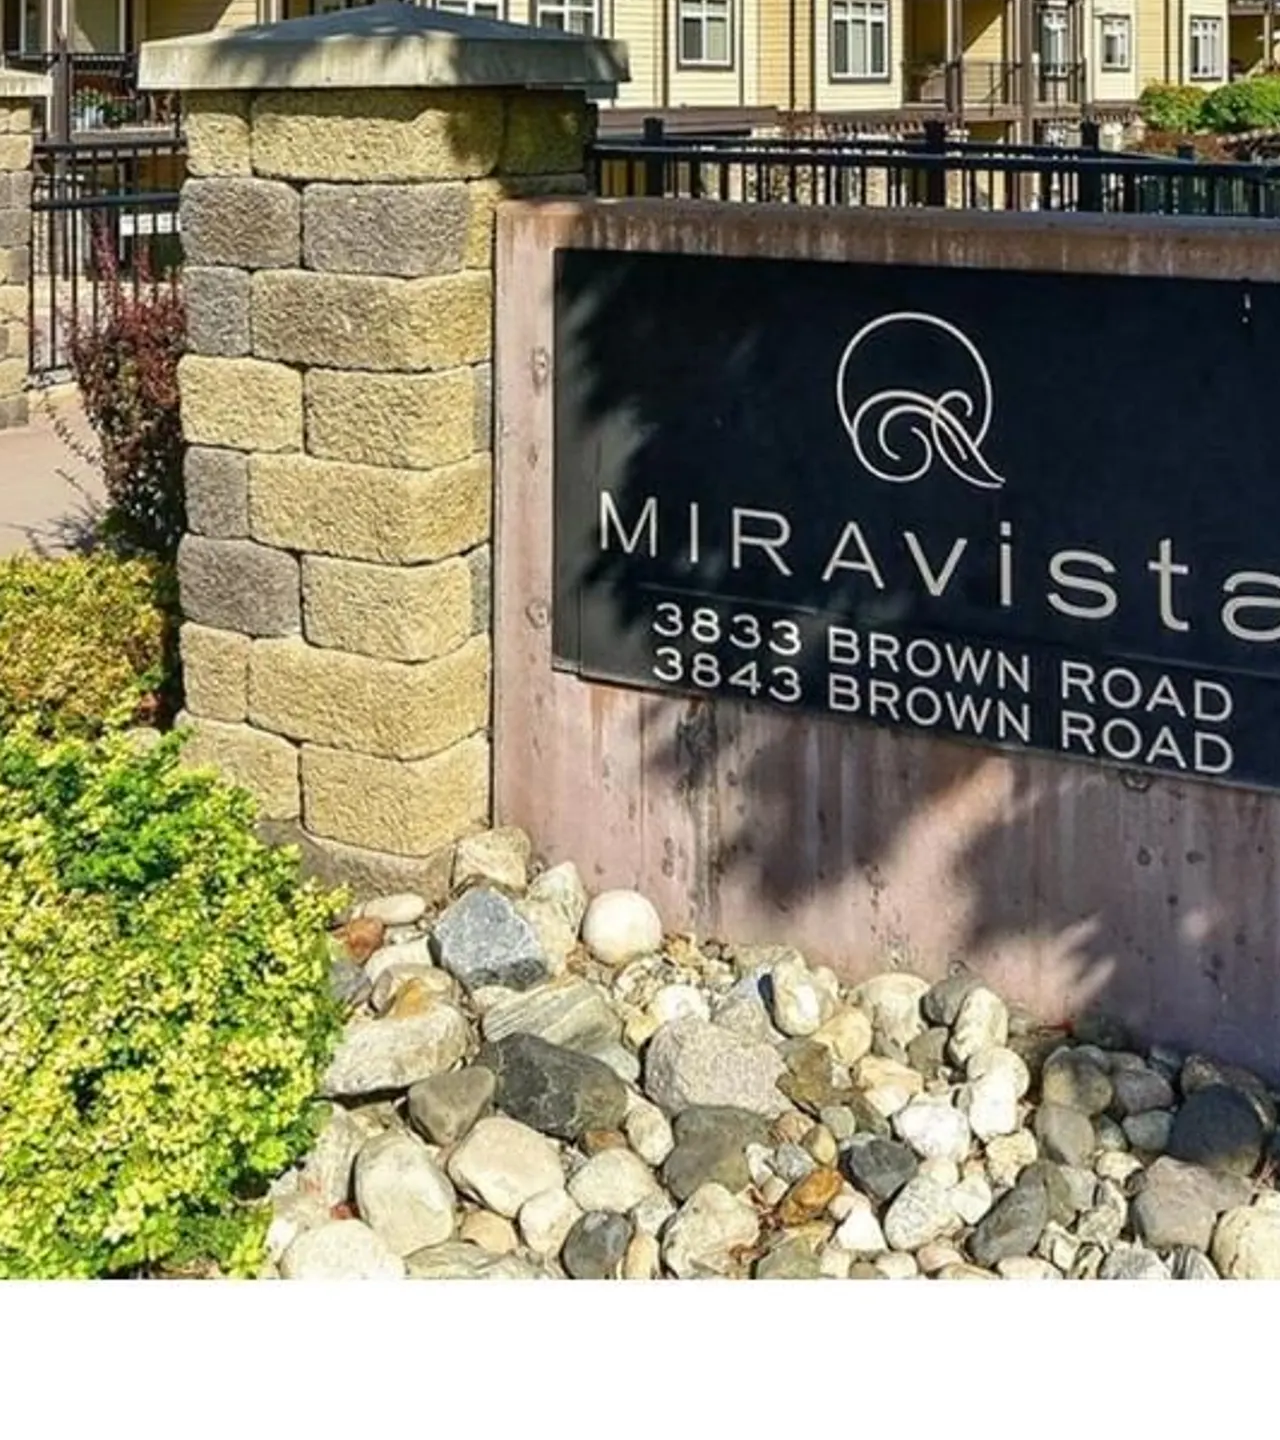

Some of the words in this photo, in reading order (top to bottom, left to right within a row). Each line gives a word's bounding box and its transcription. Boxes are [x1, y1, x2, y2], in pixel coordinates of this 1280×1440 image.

[652, 603, 803, 656] 3833
[827, 626, 1031, 694] BROWN
[1061, 661, 1233, 723] ROAD
[652, 647, 803, 703] 3843
[828, 674, 1031, 743] BROWN
[1061, 710, 1234, 775] ROAD
